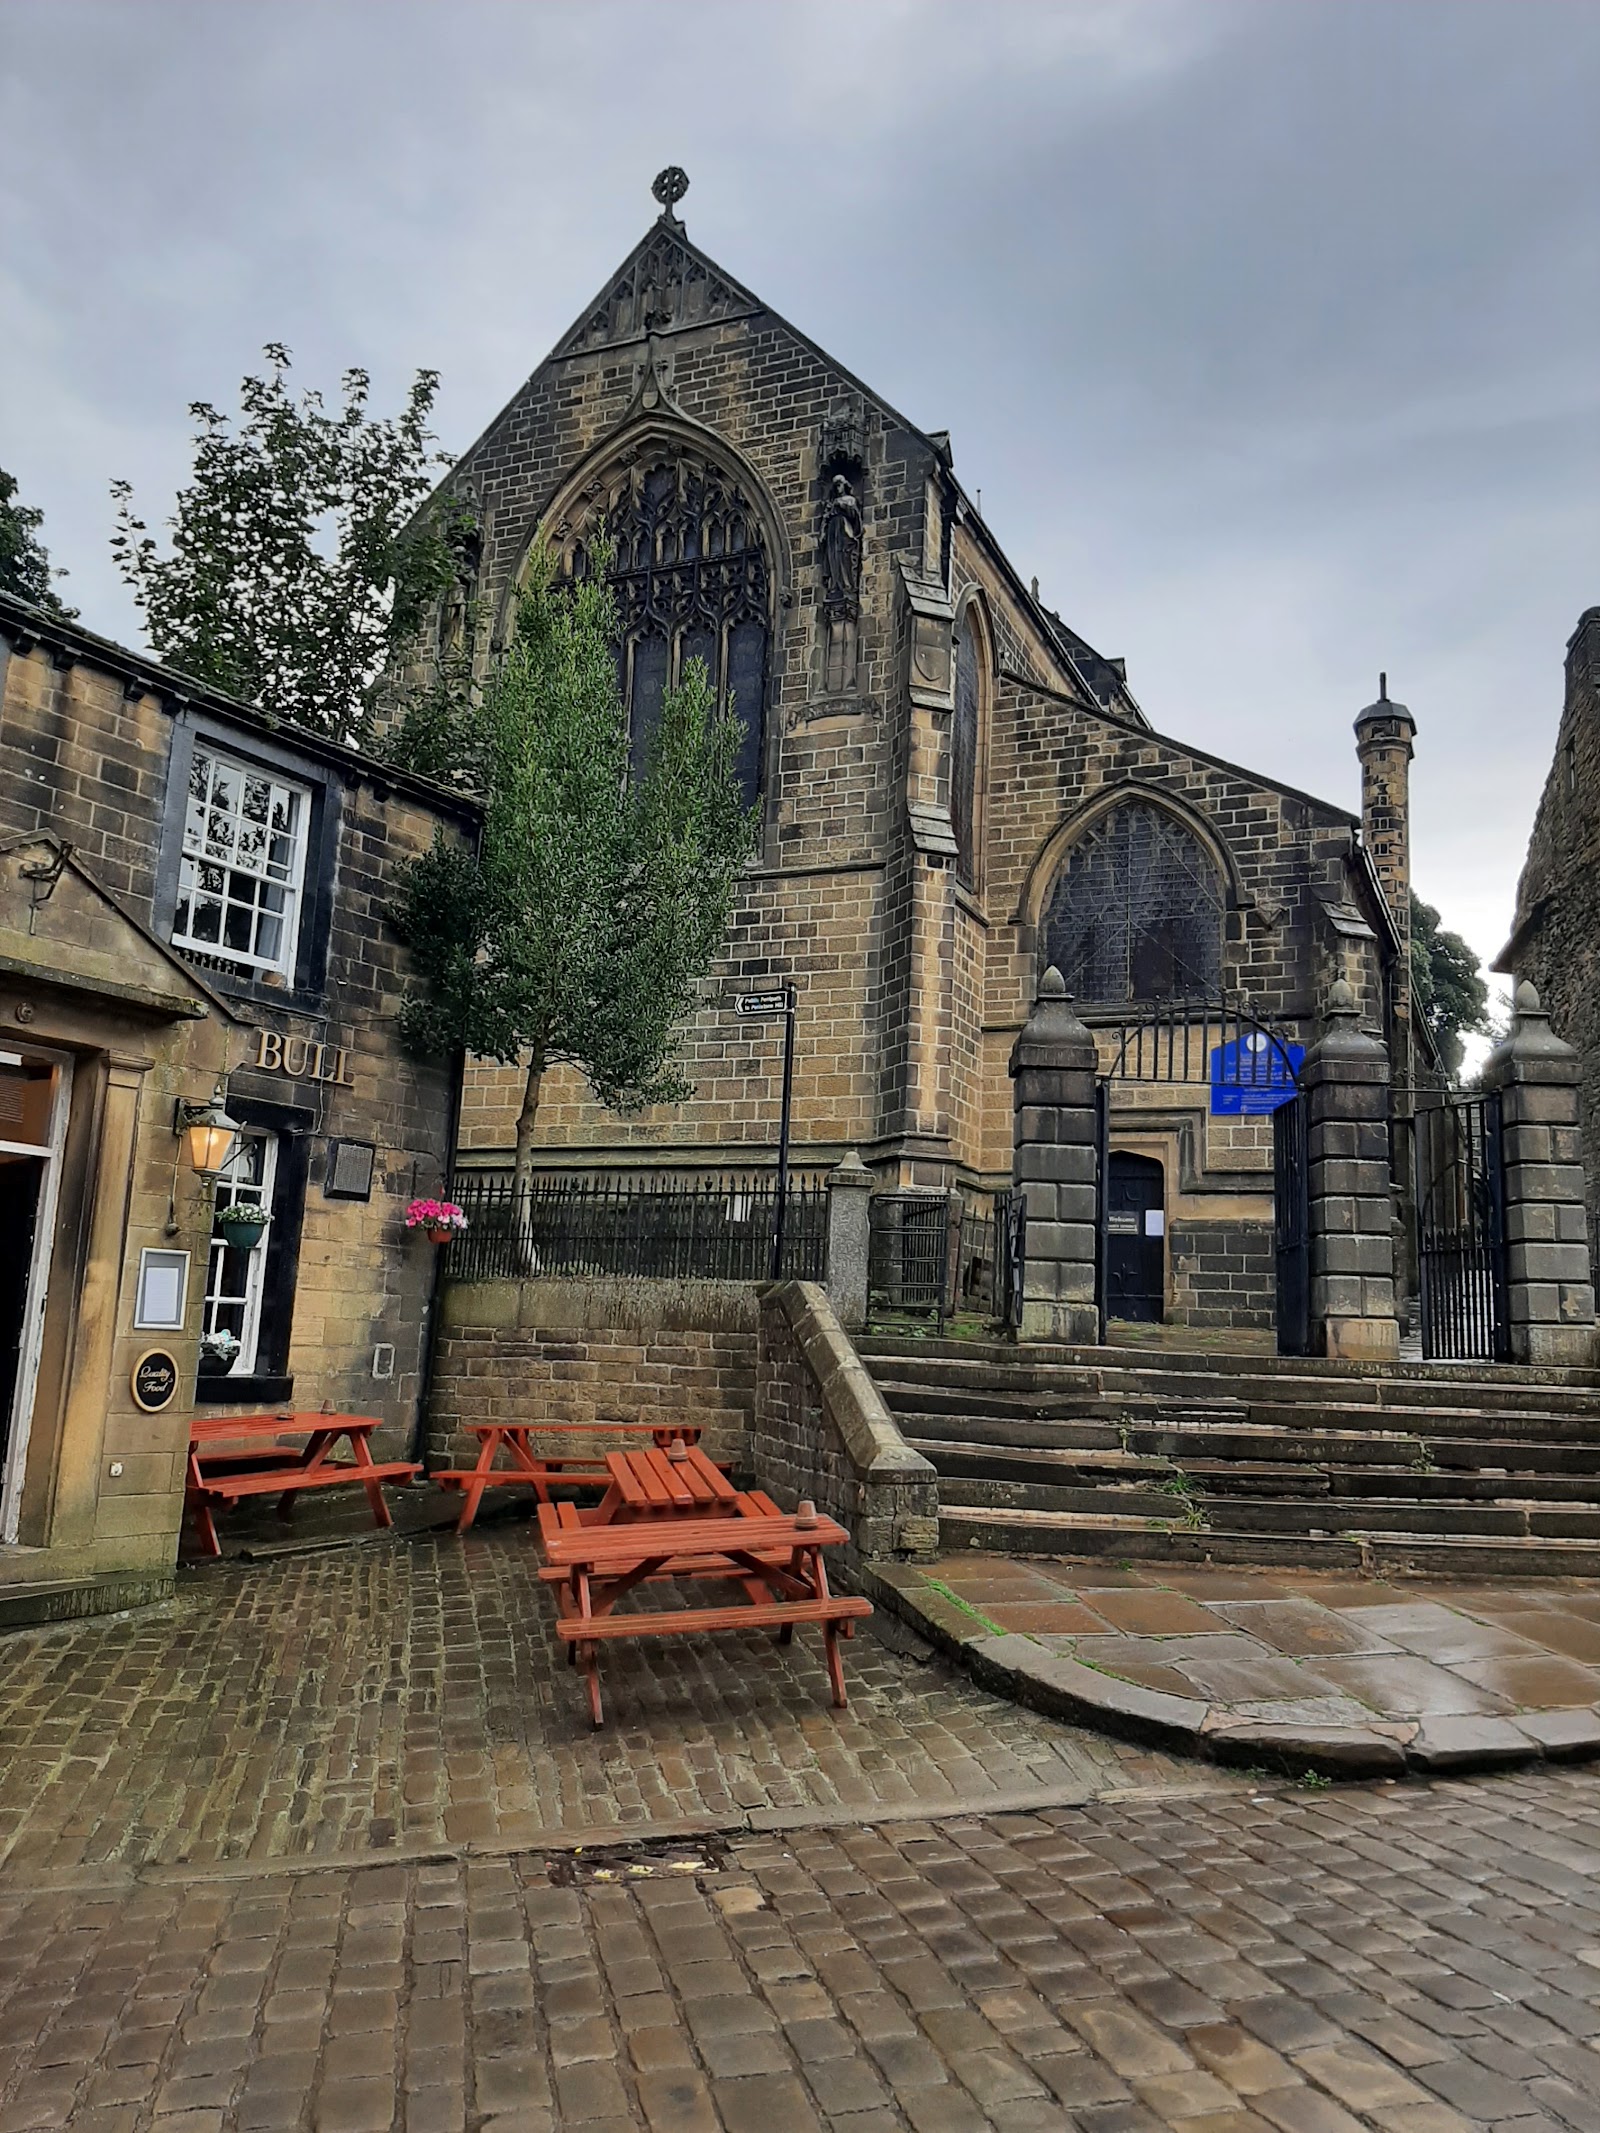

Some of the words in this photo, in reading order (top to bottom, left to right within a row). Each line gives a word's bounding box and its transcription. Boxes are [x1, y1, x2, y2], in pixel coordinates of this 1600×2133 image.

[254, 1028, 356, 1088] BULL
[139, 1365, 173, 1382] Quality
[142, 1381, 168, 1392] Food
